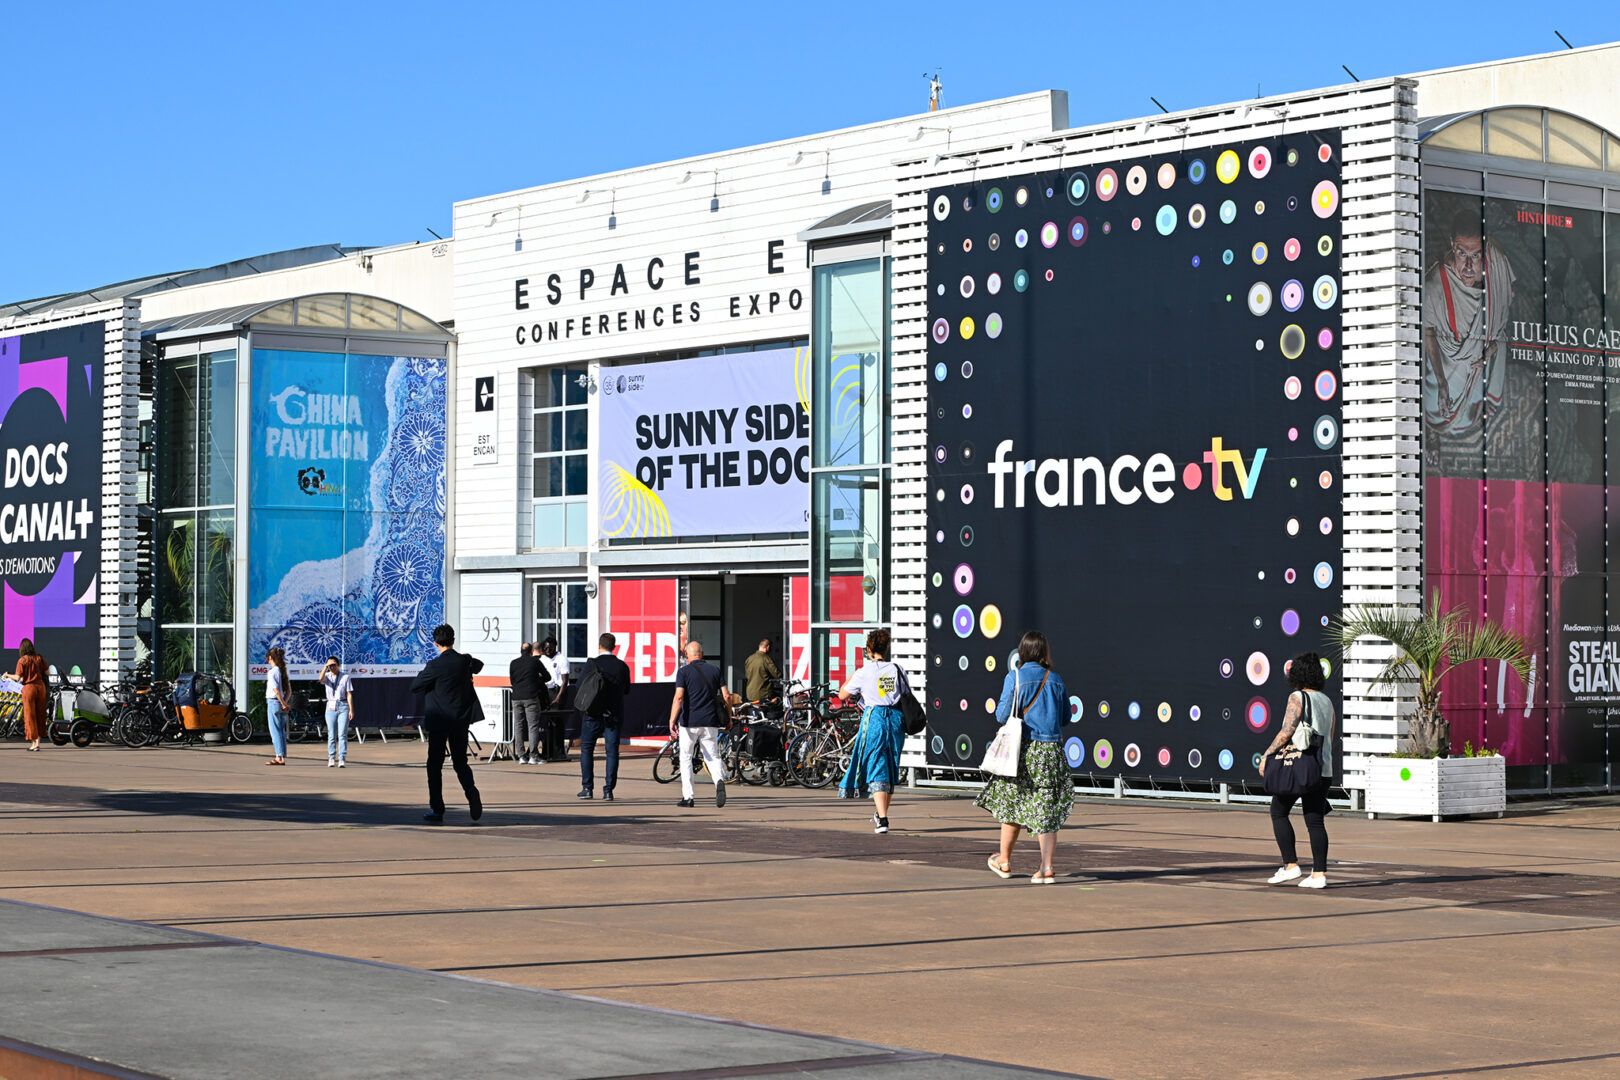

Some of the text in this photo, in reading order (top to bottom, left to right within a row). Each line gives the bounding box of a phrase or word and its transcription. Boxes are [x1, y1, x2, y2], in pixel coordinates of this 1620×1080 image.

[1517, 210, 1565, 228] HISTOIRE
[515, 251, 701, 310] ESPACE
[516, 288, 803, 345] CONFERENCES EXPO
[1511, 348, 1533, 361] THE
[1535, 350, 1580, 365] MAKING
[1582, 354, 1596, 366] OF
[1597, 356, 1605, 367] A
[478, 435, 490, 444] EST
[636, 402, 810, 451] SUNNY SIDE
[265, 427, 369, 461] PAVILION
[473, 446, 496, 455] ENCAN
[4, 442, 69, 488] DOCS
[635, 445, 810, 491] OF THE DOC
[0, 498, 94, 545] CANAL+
[5, 556, 56, 575] D'EMOTIONS
[482, 616, 500, 642] 93
[611, 632, 677, 684] ZED
[1568, 640, 1620, 663] STEAL
[1568, 663, 1620, 693] GIAN
